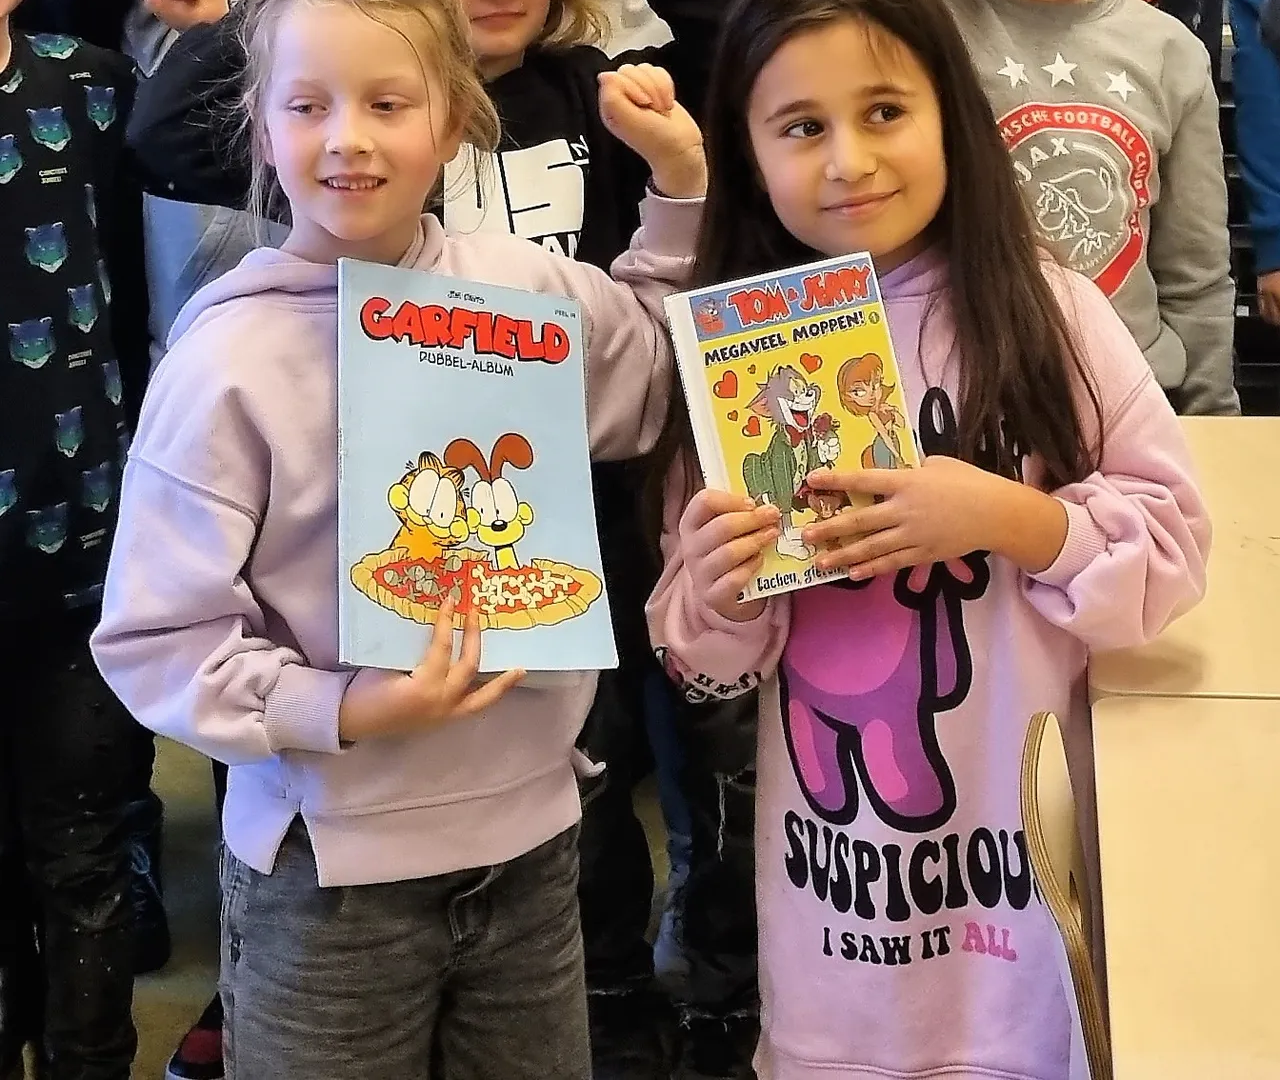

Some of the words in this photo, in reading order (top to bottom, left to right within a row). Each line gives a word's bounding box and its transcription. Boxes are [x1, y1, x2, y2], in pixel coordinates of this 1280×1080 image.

[1053, 109, 1135, 151] FOOTBALL
[1013, 136, 1071, 184] JAX
[728, 285, 789, 326] TOM
[799, 265, 871, 312] JERRY
[360, 296, 570, 365] GARFIELD
[704, 332, 787, 367] MEGAVEEL
[792, 312, 866, 342] MOPPEN!
[419, 351, 514, 377] DUBBEL-ALBUM
[756, 570, 801, 593] Lachen,
[784, 810, 1041, 922] SUSPICIOU
[822, 927, 833, 957] I
[840, 931, 912, 965] SAW
[920, 925, 951, 960] IT
[961, 922, 1018, 963] ALL
